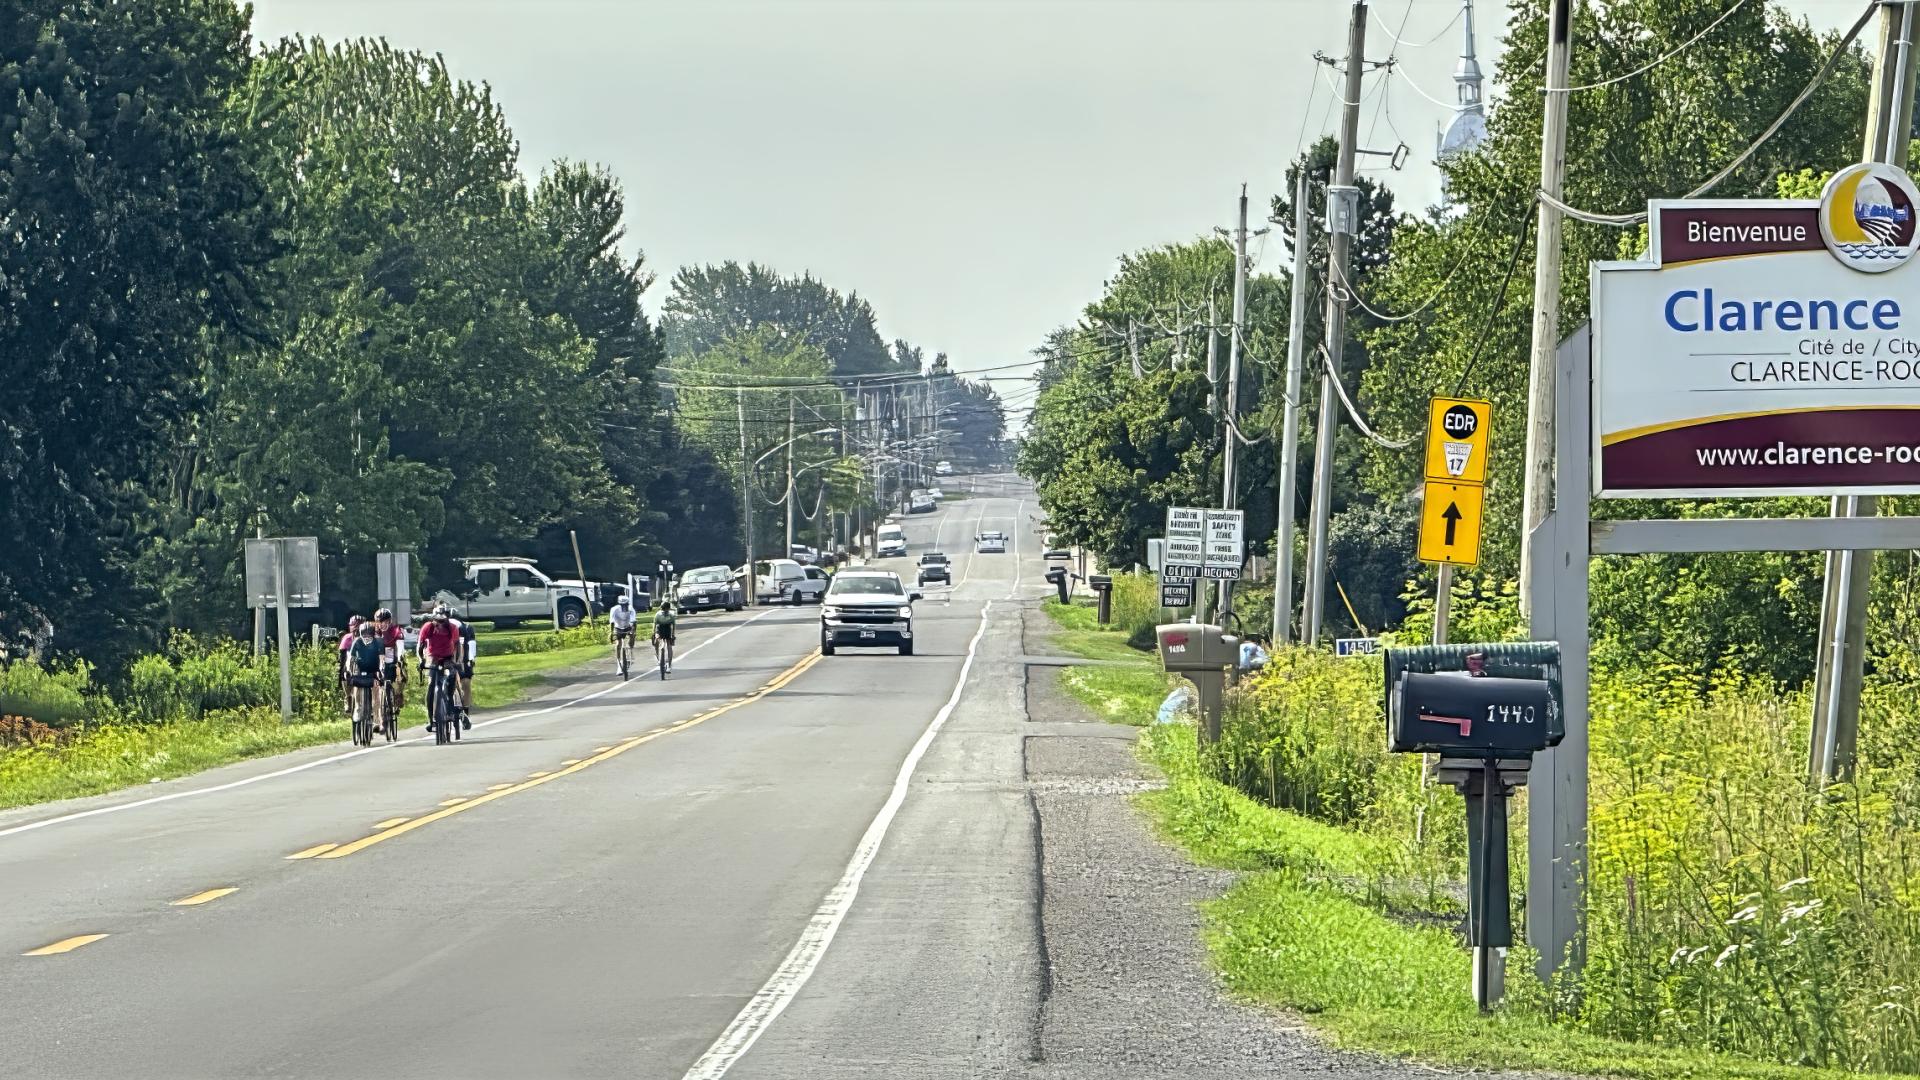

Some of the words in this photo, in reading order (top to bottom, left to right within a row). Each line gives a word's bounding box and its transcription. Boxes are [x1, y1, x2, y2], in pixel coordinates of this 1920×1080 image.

[1688, 222, 1806, 242] Bienvenue
[1665, 288, 1901, 332] Clarence
[1798, 338, 1834, 356] Cité
[1842, 338, 1865, 355] de
[1872, 338, 1881, 357] /
[1888, 337, 1920, 358] City
[1444, 412, 1475, 431] EDR
[1449, 458, 1464, 471] 17
[1487, 704, 1535, 723] 1440
